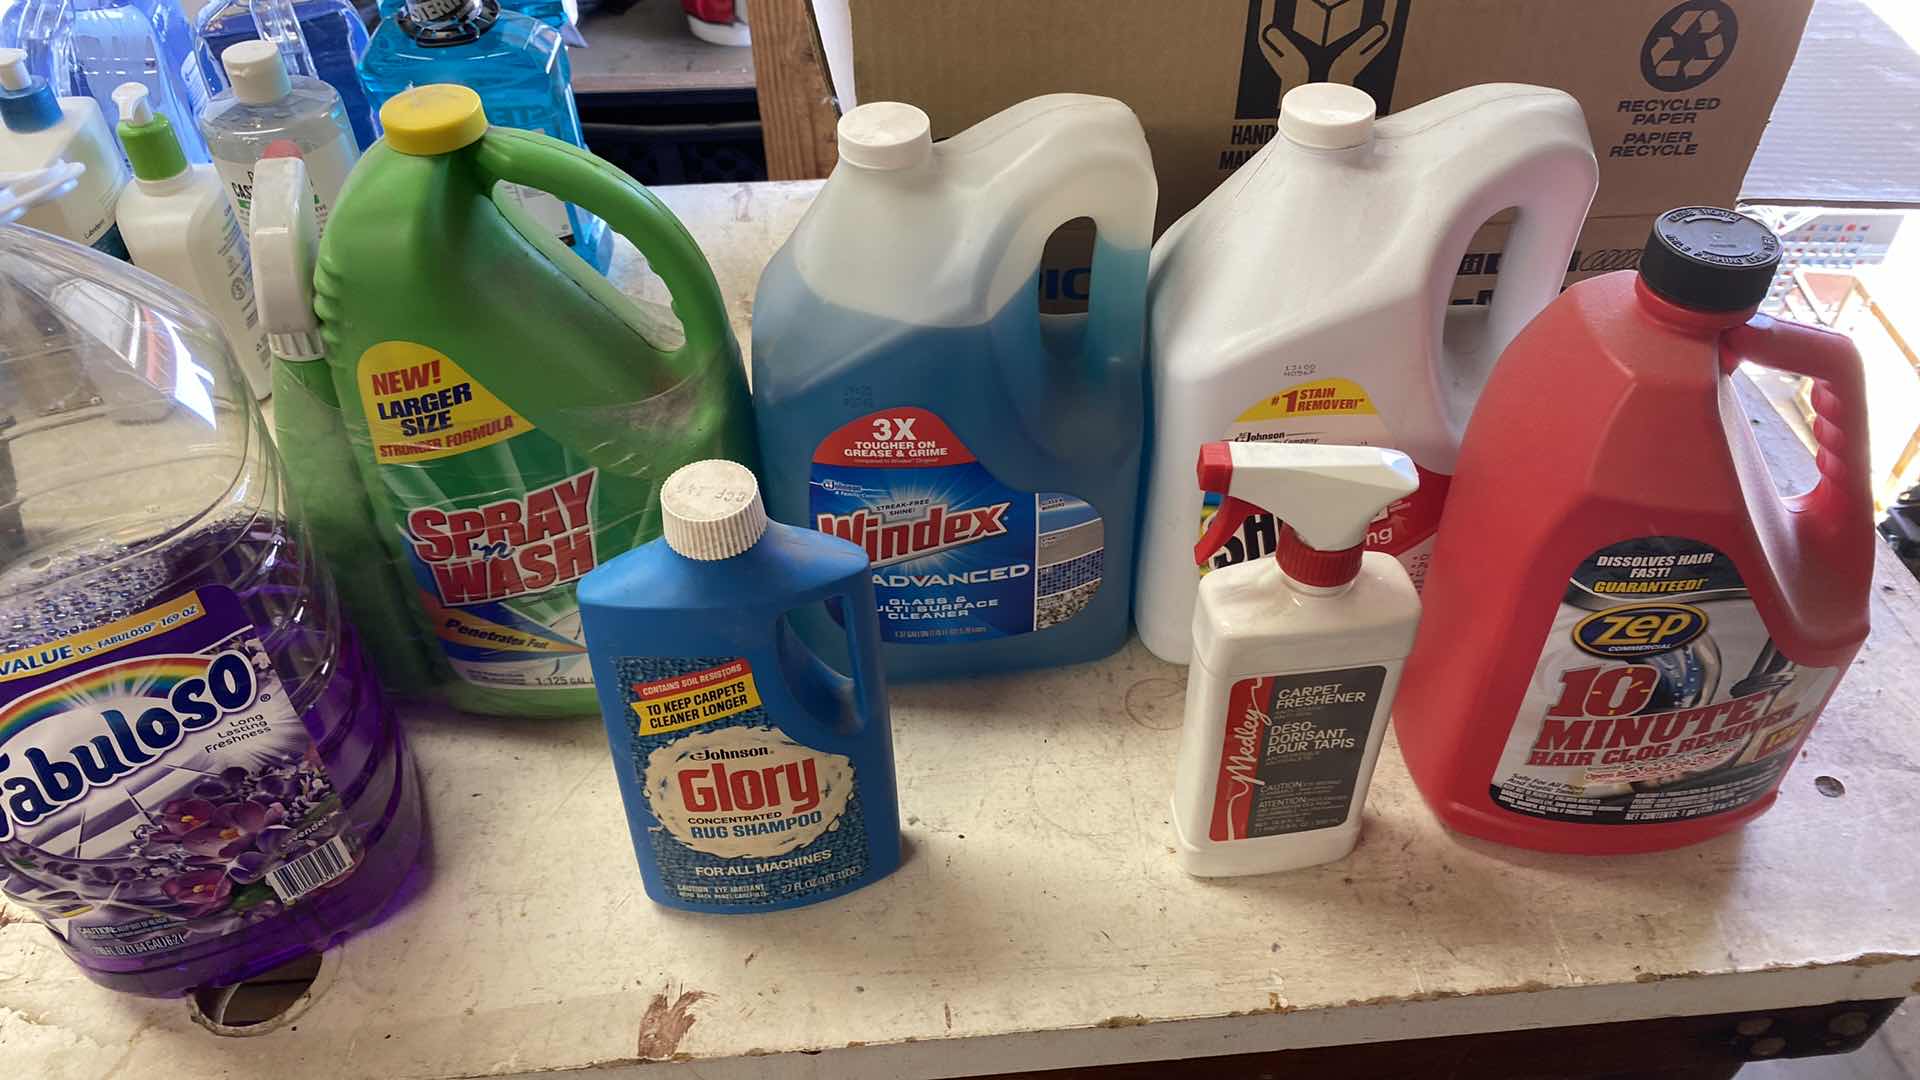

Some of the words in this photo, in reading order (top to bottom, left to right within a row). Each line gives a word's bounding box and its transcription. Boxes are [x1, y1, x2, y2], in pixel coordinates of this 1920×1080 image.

[1617, 98, 1721, 112] RECYCLED
[1632, 112, 1697, 125] PAPER
[1623, 132, 1693, 144] PAPIER
[1608, 144, 1699, 157] RECYCLE
[372, 360, 441, 396] NEW!
[377, 382, 473, 420] LARGER
[1299, 388, 1336, 400] STAIN
[400, 411, 454, 437] SIZE
[872, 418, 917, 441] 3X
[380, 438, 442, 458] STRONGER
[446, 415, 514, 448] FORMULA
[855, 441, 915, 450] TOUGHER
[918, 441, 936, 449] ON
[844, 449, 893, 458] GREASE
[895, 449, 905, 457] &
[909, 448, 948, 457] GRIME
[876, 499, 930, 511] STREAK-FREE
[889, 508, 915, 516] SHINE!
[410, 471, 596, 561] SPRAY
[819, 504, 1008, 562] Windex
[1207, 513, 1278, 569] SH
[432, 527, 595, 602] WASH
[1597, 555, 1676, 567] DISSOLVES
[1677, 553, 1714, 565] HAIR
[872, 564, 1029, 587] ADVANCED
[1630, 568, 1671, 578] FAST!
[889, 597, 947, 606] GLASS
[888, 610, 969, 620] CLEANER
[0, 645, 73, 675] VALUE
[161, 613, 180, 626] 169
[182, 606, 198, 617] OZ
[1609, 644, 1673, 652] COMMERCIAL
[642, 681, 680, 696] CONTAINS
[682, 676, 698, 689] SOIL
[700, 664, 742, 683] RESISTORS
[646, 704, 661, 716] TO
[664, 698, 691, 713] KEEP
[694, 682, 745, 706] CARPETS
[1276, 692, 1366, 709] FRESHENER
[1278, 684, 1342, 699] CARPET
[1546, 665, 1660, 717] 10
[230, 714, 264, 728] Long
[650, 711, 700, 729] CLEANER
[703, 695, 748, 717] LONGER
[1533, 692, 1776, 750] MINUTE
[217, 720, 268, 740] Lasting
[1269, 728, 1348, 746] DORISANT
[1271, 721, 1317, 735] DESO-
[1526, 750, 1597, 766] HAIR
[1602, 744, 1673, 765] CLOG
[1677, 703, 1798, 754] REMOVER
[205, 726, 272, 754] Freshness
[1226, 706, 1270, 786] Medley
[1266, 741, 1308, 756] POUR
[1314, 738, 1355, 749] TAPIS
[690, 746, 769, 762] Johnson
[677, 758, 821, 815] Glory
[688, 811, 783, 825] CONCENTRATED
[690, 825, 729, 839] RUG
[732, 811, 823, 836] SHAMPOO
[695, 865, 726, 877] FOR
[727, 865, 754, 876] ALL
[755, 849, 833, 873] MACHINES
